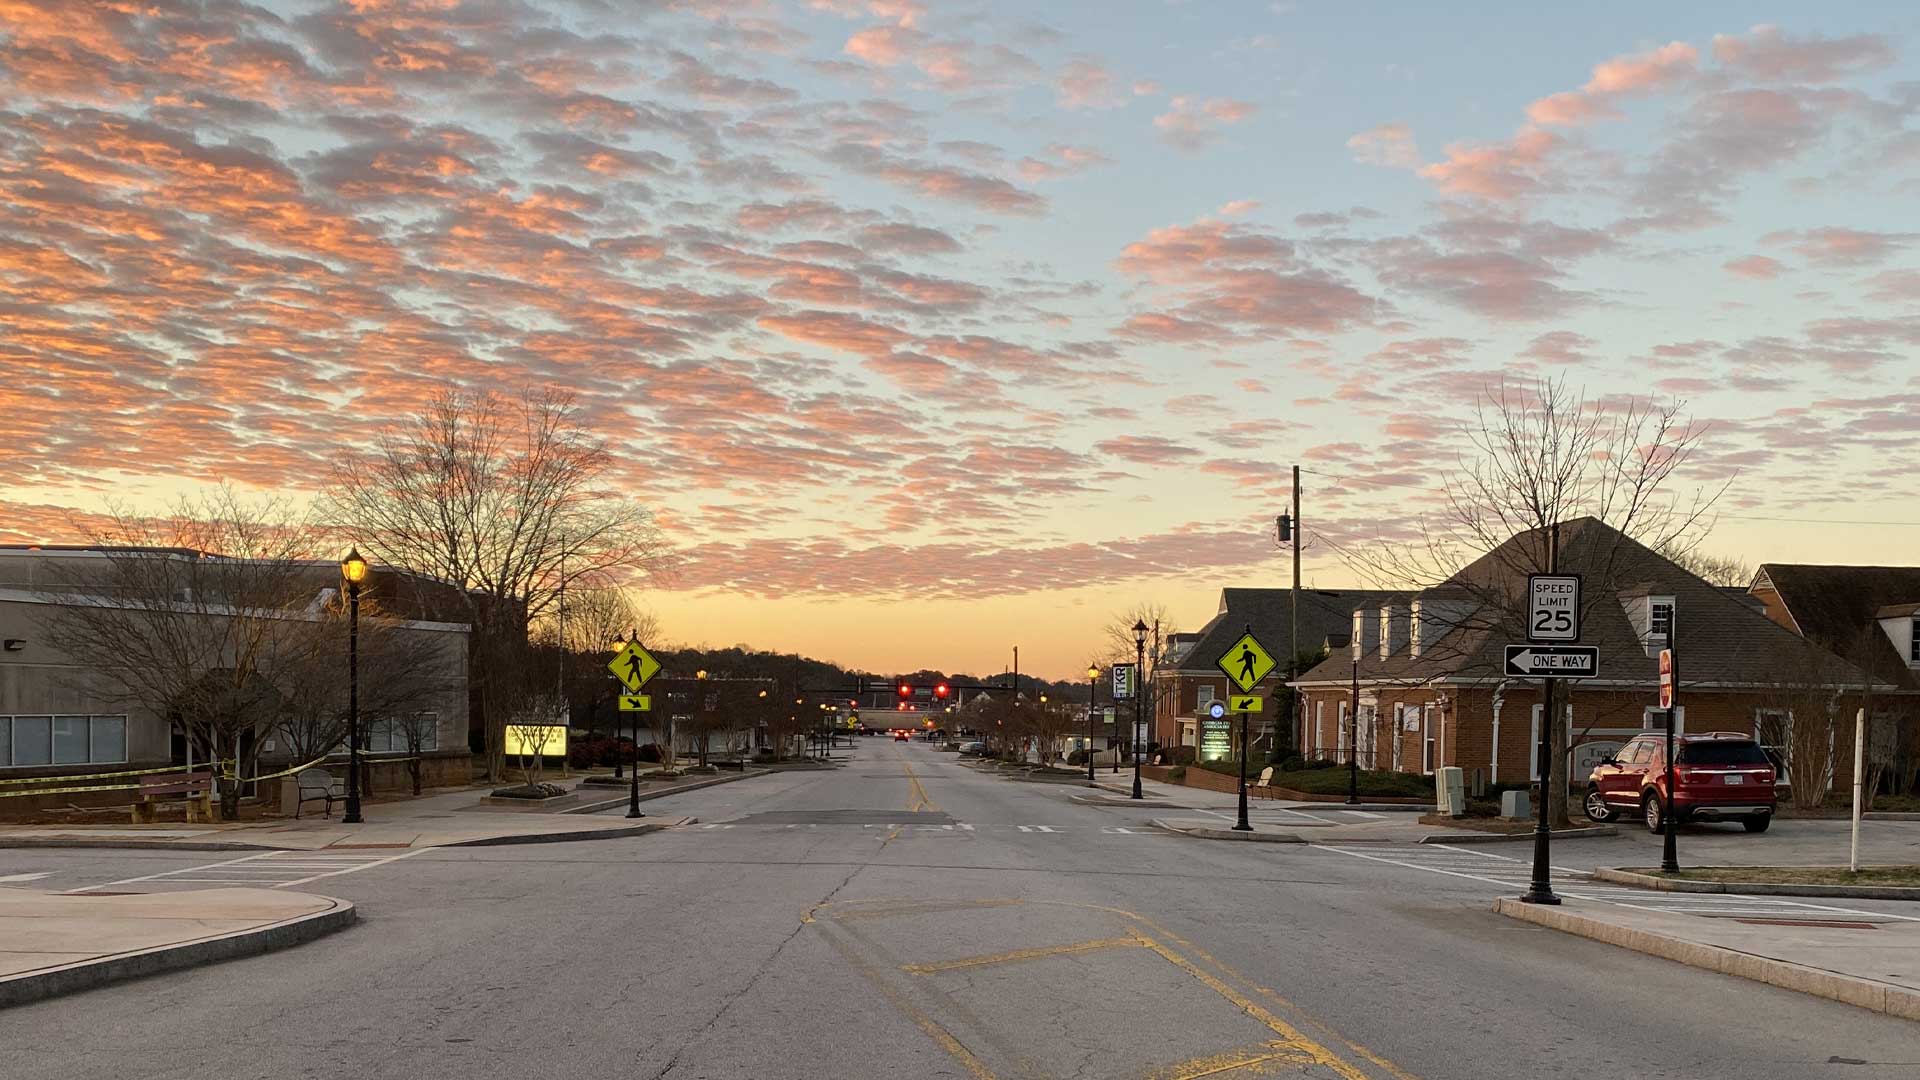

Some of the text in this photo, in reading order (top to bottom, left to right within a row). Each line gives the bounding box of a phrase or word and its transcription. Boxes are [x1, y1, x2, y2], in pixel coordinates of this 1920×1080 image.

[1535, 584, 1574, 594] SPEED
[1539, 597, 1569, 606] LIMIT
[1535, 610, 1572, 632] 25
[1533, 655, 1587, 668] ONE WAY
[1115, 667, 1126, 693] TKR
[1588, 747, 1615, 757] Tuck
